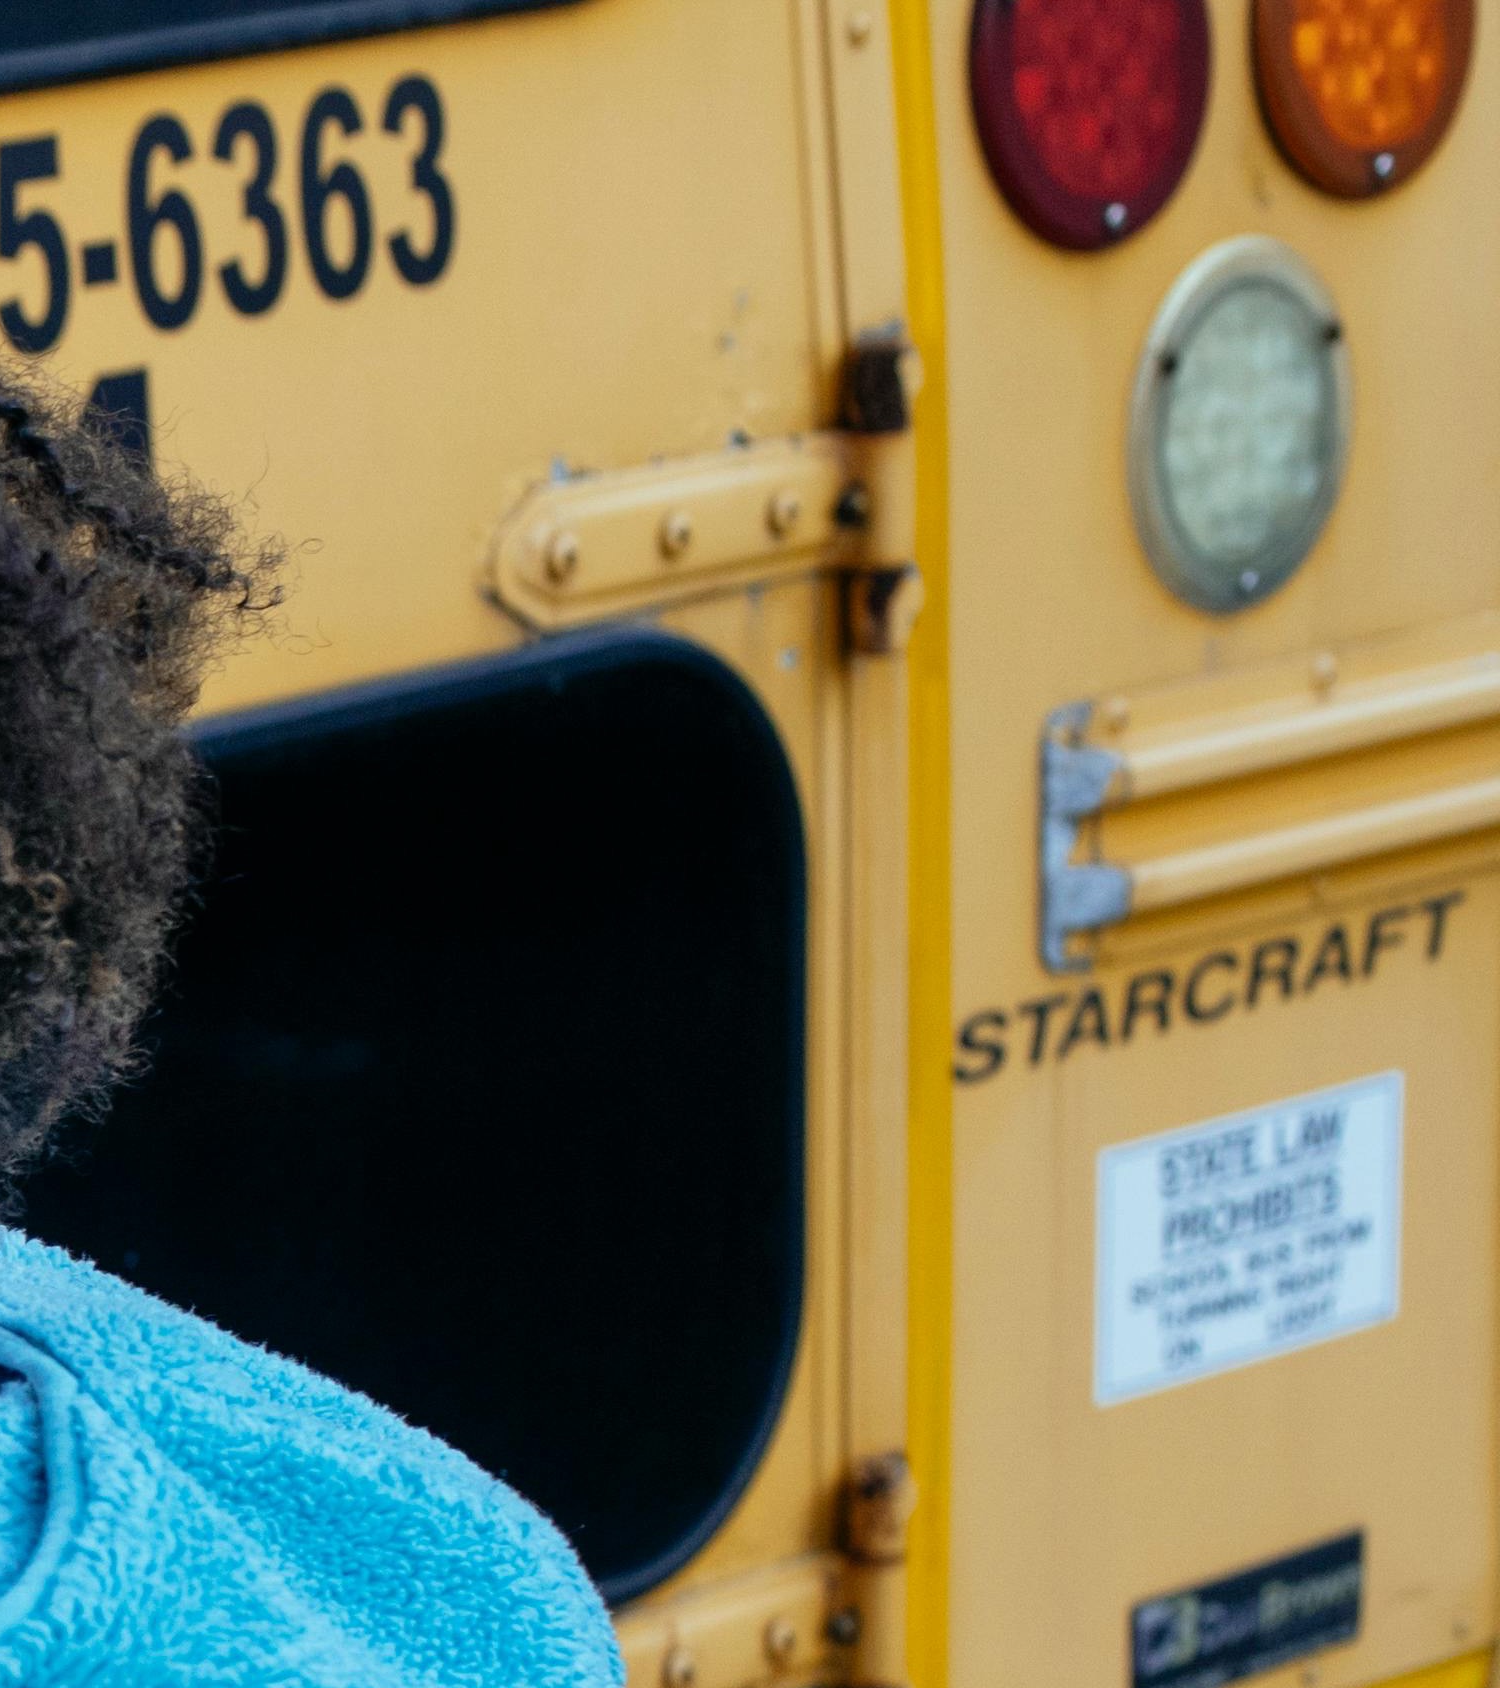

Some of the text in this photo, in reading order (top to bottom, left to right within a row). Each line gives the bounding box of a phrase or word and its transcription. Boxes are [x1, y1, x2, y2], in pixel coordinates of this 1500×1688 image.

[952, 890, 1464, 1084] STARCRAFT
[1157, 1110, 1342, 1199] STATE LAW
[1160, 1166, 1342, 1258] PROHIBITS
